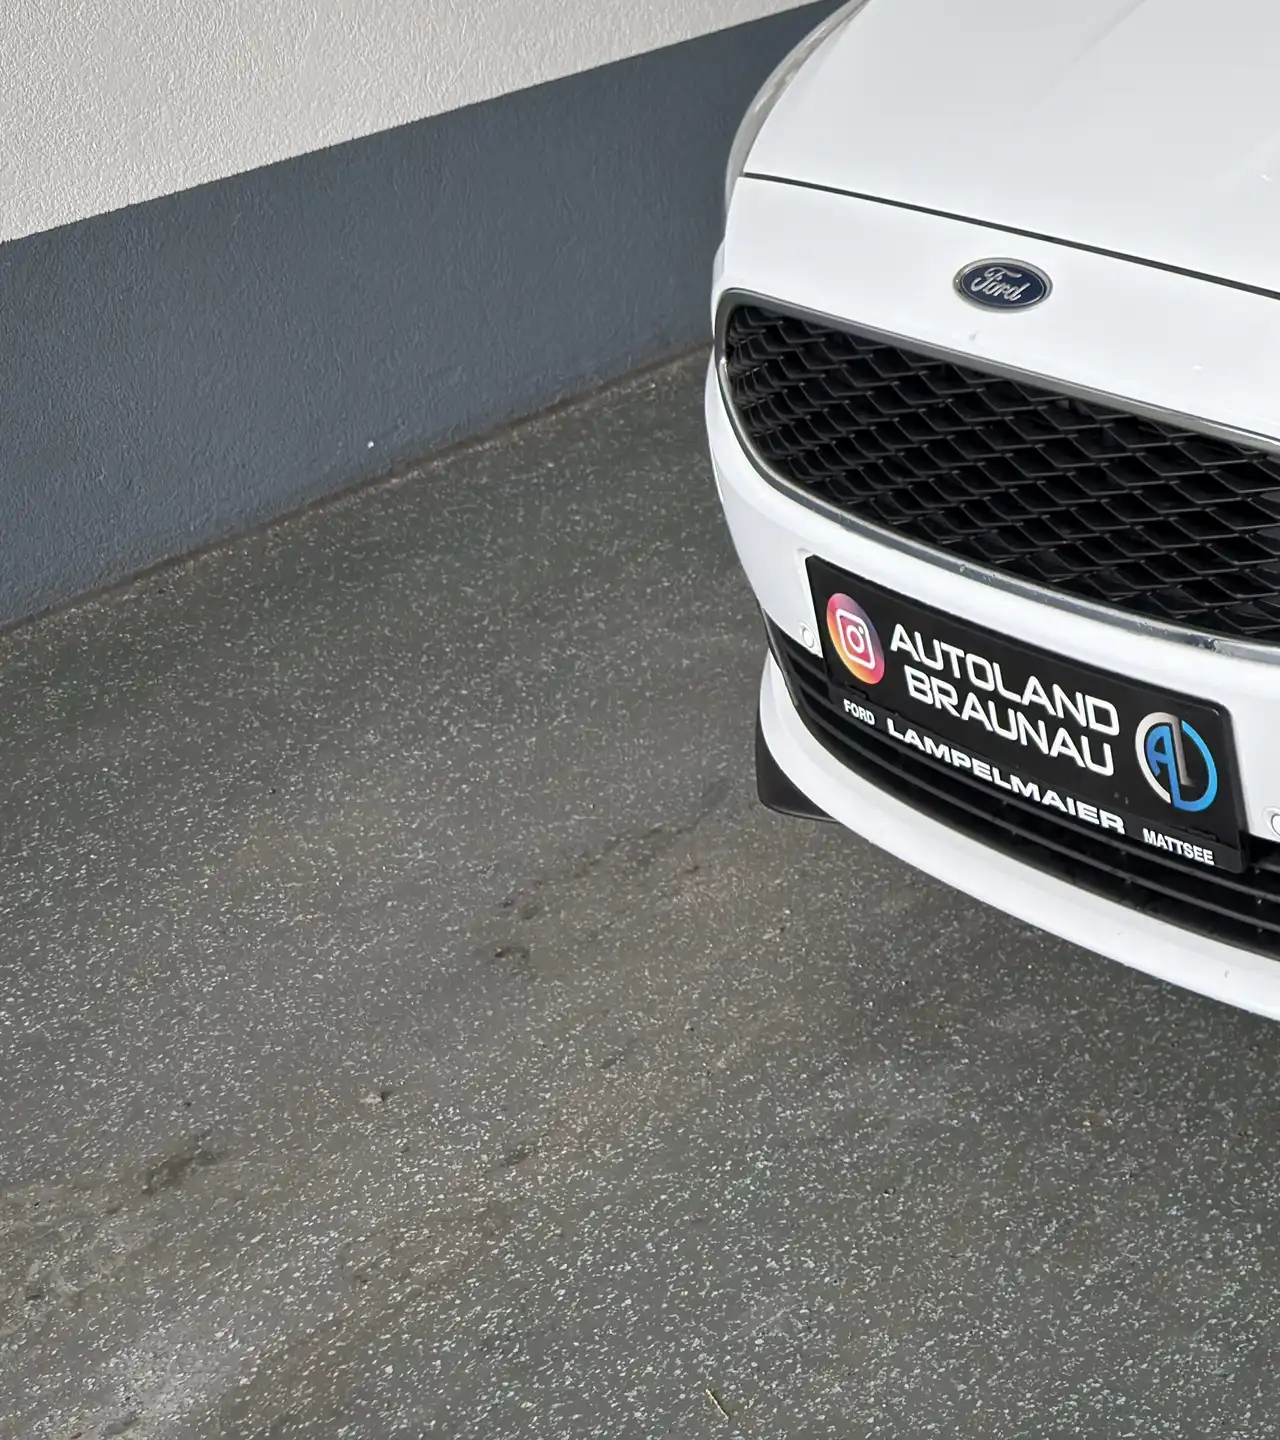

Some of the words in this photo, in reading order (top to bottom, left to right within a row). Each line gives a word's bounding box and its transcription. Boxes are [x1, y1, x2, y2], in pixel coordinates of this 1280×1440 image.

[971, 266, 1031, 302] Ford
[891, 623, 1120, 737] AUTOLAND
[903, 666, 1114, 777] BRAUNAU
[843, 698, 876, 726] FORD
[886, 717, 1125, 835] LAMPELMAIER
[1142, 827, 1215, 866] MATTSEE
